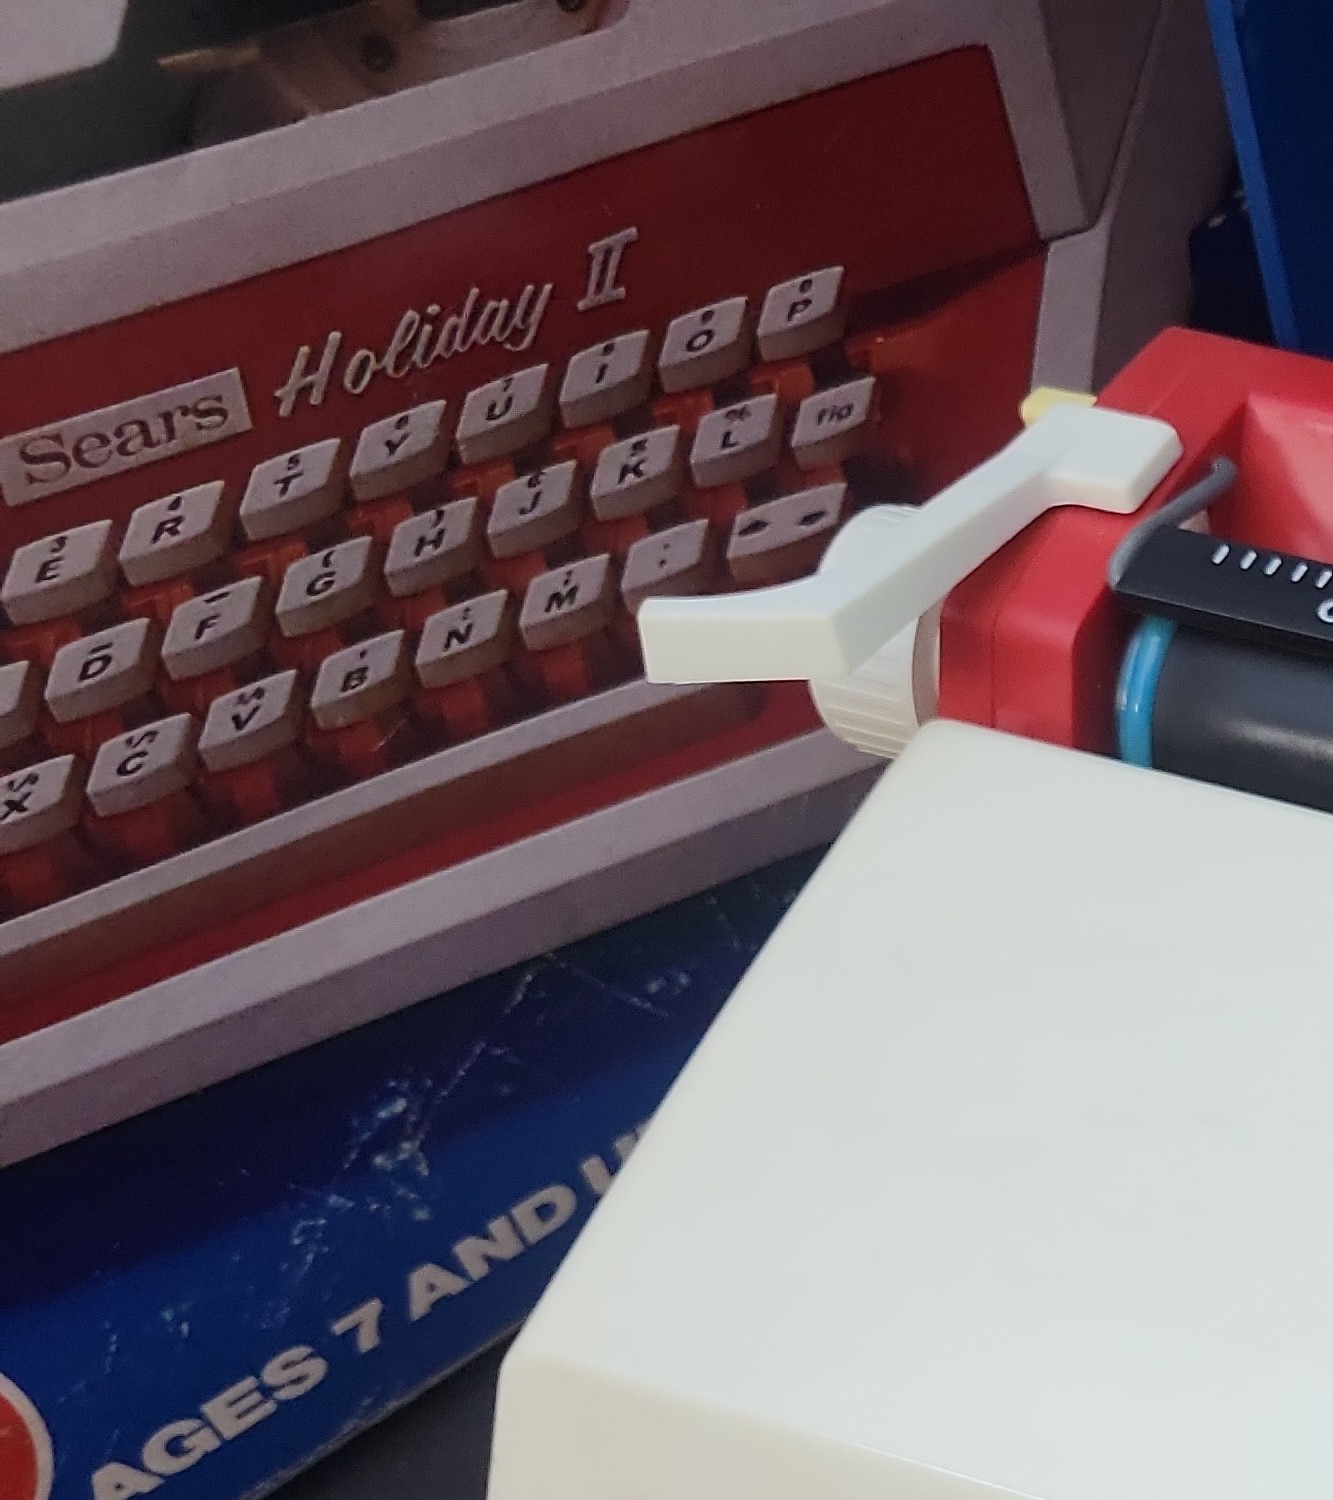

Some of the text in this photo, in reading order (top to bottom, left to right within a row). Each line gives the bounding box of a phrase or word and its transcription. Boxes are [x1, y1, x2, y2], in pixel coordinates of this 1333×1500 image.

[788, 299, 812, 322] P
[273, 283, 554, 417] Holiday
[486, 396, 513, 421] U
[19, 394, 229, 485] Sears
[617, 459, 646, 485] K
[152, 515, 185, 544] R
[413, 528, 446, 557] H
[36, 555, 64, 584] E
[305, 569, 336, 597] G
[544, 584, 579, 613] M
[194, 613, 223, 641] F
[443, 622, 473, 650] N
[78, 655, 112, 683] D
[230, 704, 261, 731] V
[115, 750, 146, 778] C
[331, 1298, 384, 1354] 7
[407, 1181, 577, 1321] AND
